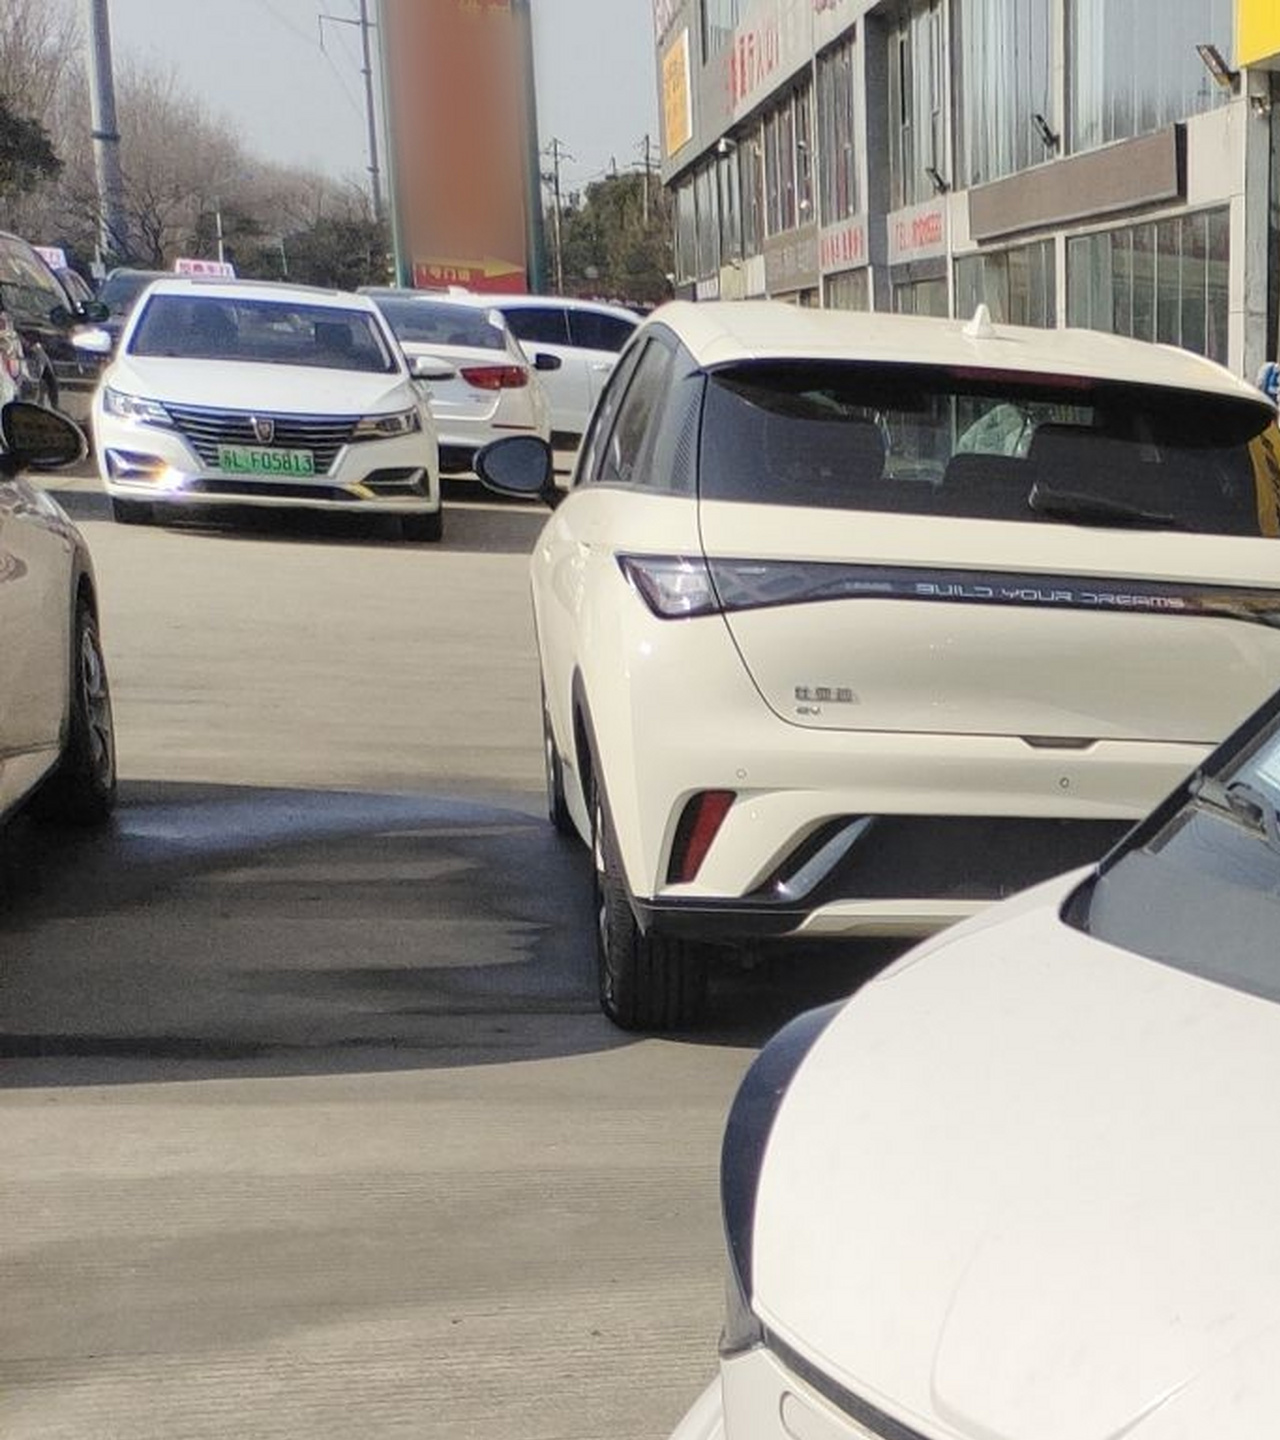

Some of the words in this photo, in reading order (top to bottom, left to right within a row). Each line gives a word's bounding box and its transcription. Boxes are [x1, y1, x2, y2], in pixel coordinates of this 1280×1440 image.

[914, 582, 993, 598] BUILD
[1000, 587, 1073, 602] YOUR
[1080, 592, 1186, 608] DREAMS
